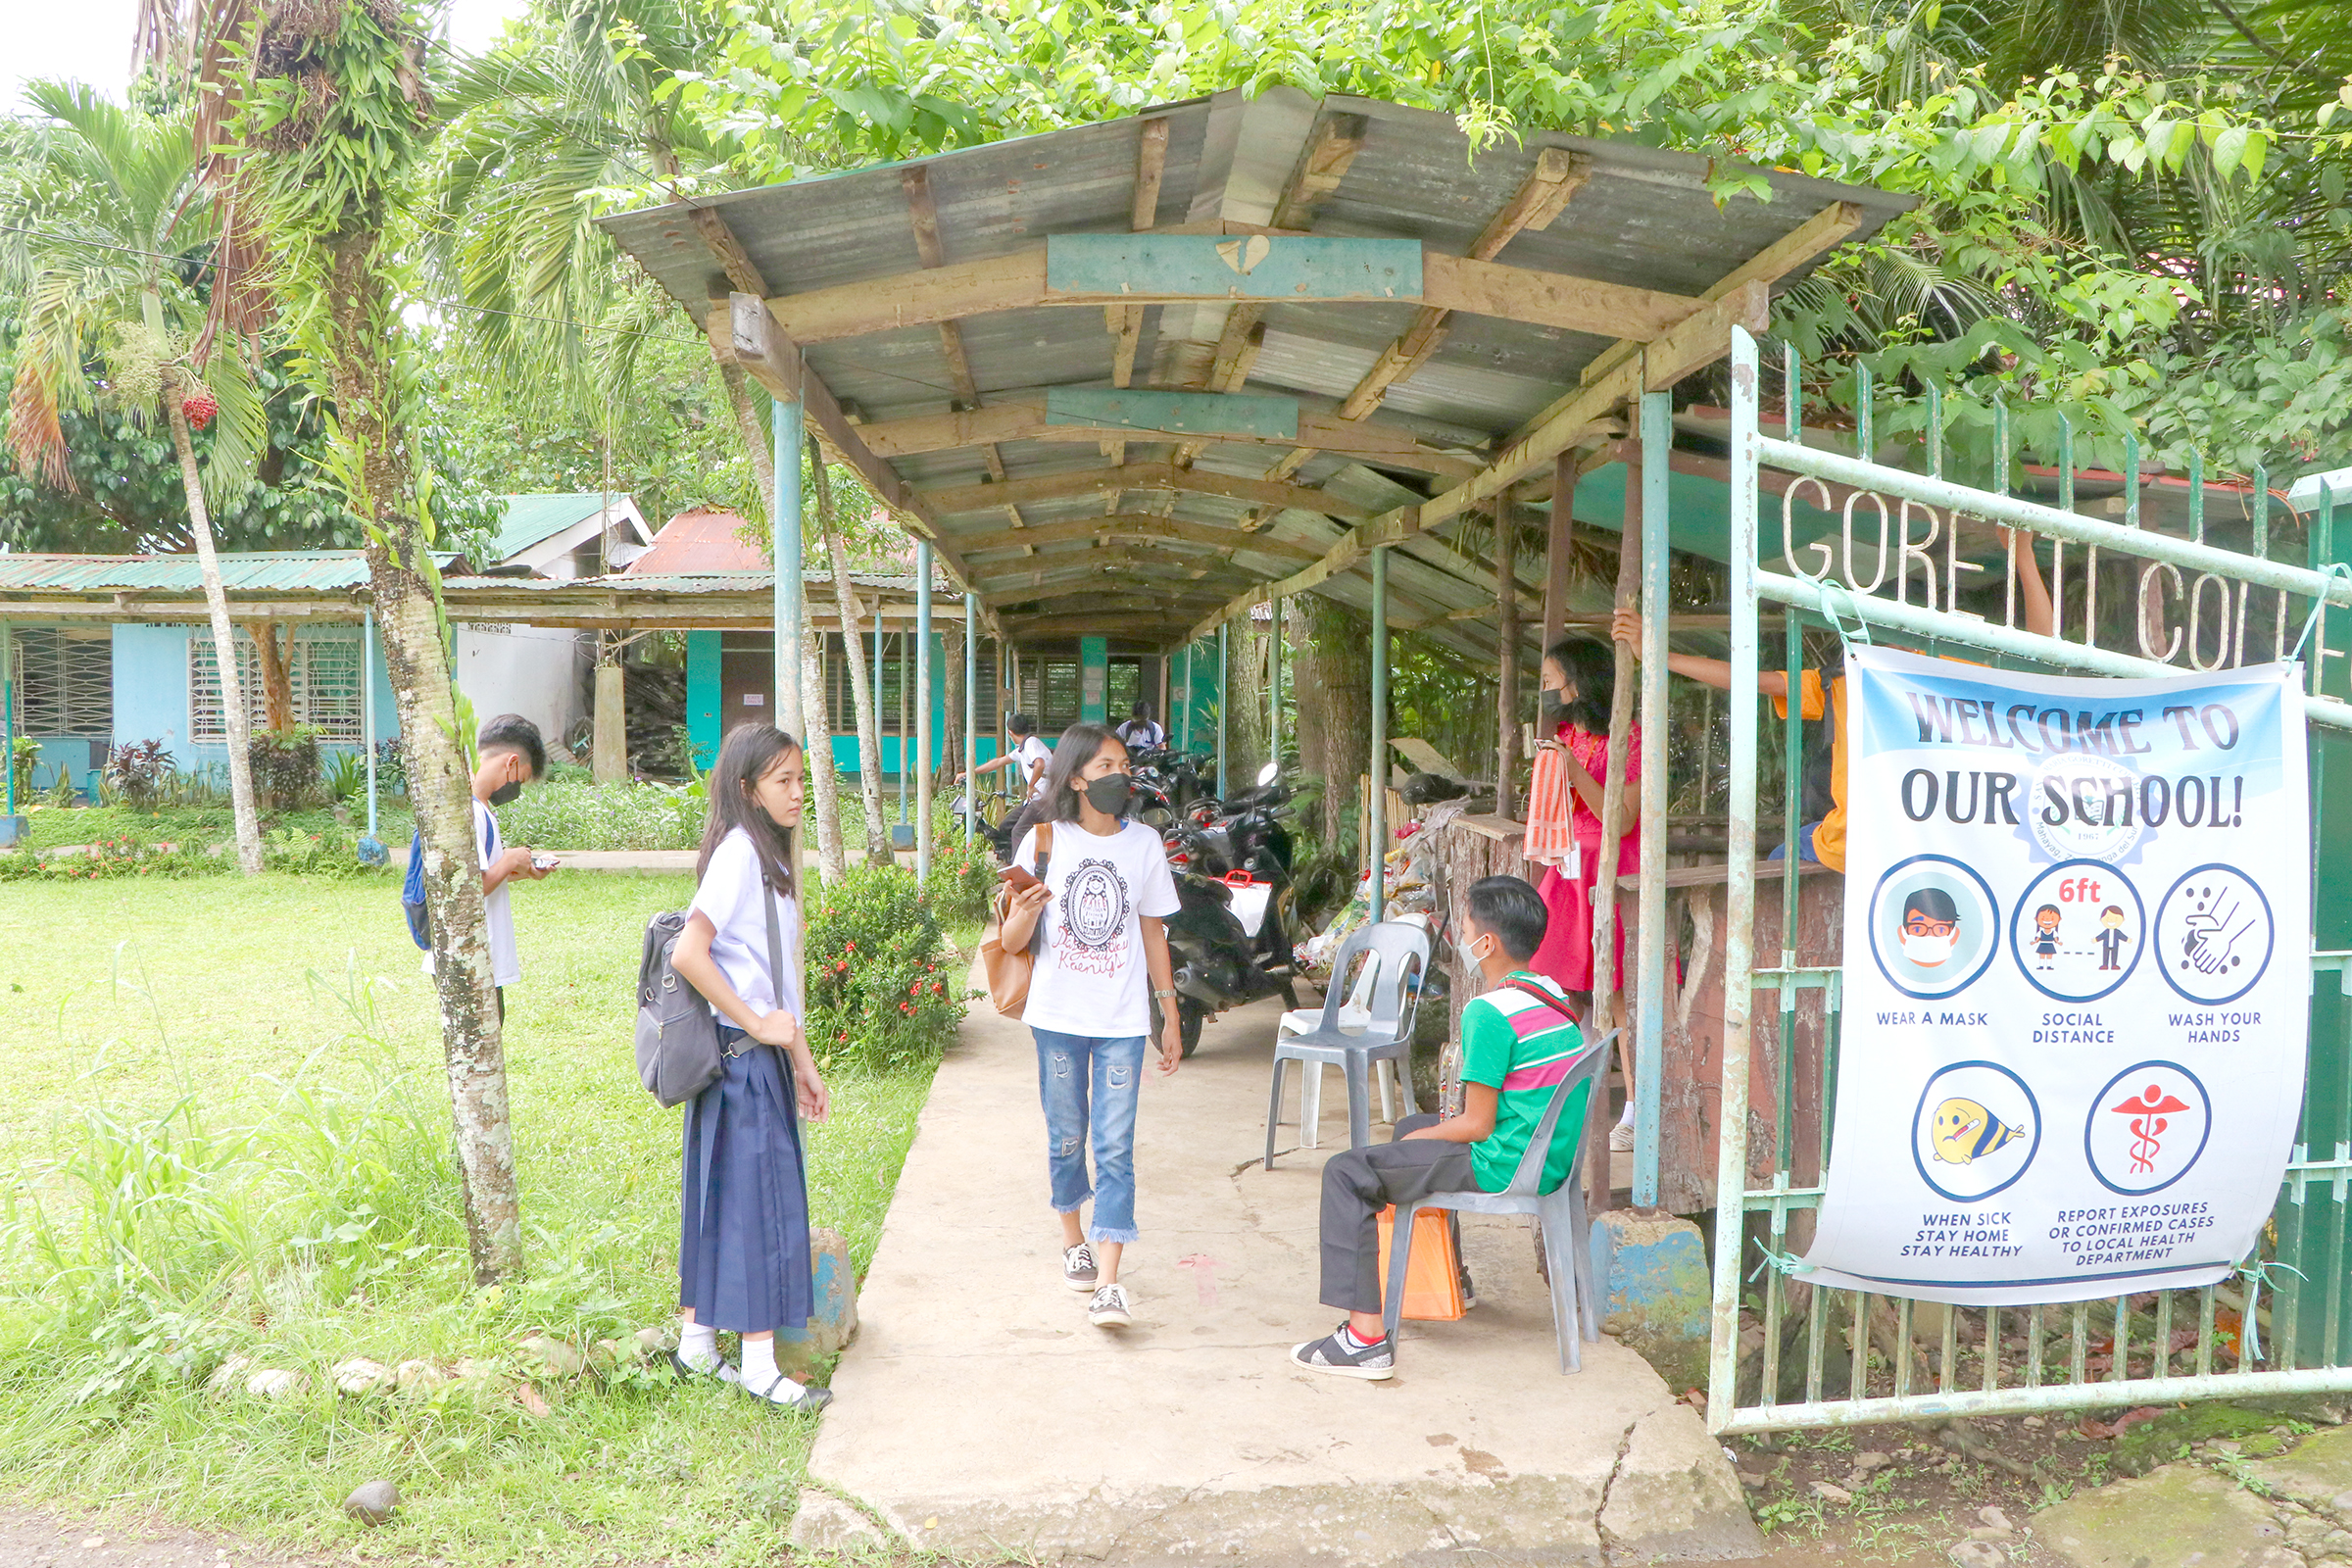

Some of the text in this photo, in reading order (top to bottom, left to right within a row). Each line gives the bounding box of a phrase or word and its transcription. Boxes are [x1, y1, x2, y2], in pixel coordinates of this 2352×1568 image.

[1782, 474, 2098, 649] GORETTI
[1905, 691, 2239, 756] WELCOME TO
[1901, 768, 2243, 828] OUR SCHOOL!
[2078, 832, 2099, 841] 1967
[2119, 840, 2131, 854] del
[2127, 826, 2138, 842] Sur
[2059, 877, 2101, 903] 6ft
[1877, 1011, 1988, 1026] WEAR A MASK
[2041, 1012, 2102, 1026] SOCIAL
[2168, 1012, 2261, 1026] WASH YOUR
[2033, 1030, 2114, 1043] DISTANCE
[2187, 1029, 2240, 1043] HANDS
[1923, 1211, 2011, 1226] WHEN SICK
[2057, 1201, 2208, 1223] REPORT EXPOSURES
[1915, 1229, 2009, 1242] STAY HOME
[2048, 1215, 2215, 1240] OR CONFIRMED CASES
[2062, 1232, 2195, 1253] TO LOCAL HEALTH
[1900, 1246, 2023, 1256] STAY HEALTHY
[2076, 1248, 2173, 1266] DEPARTMENT
